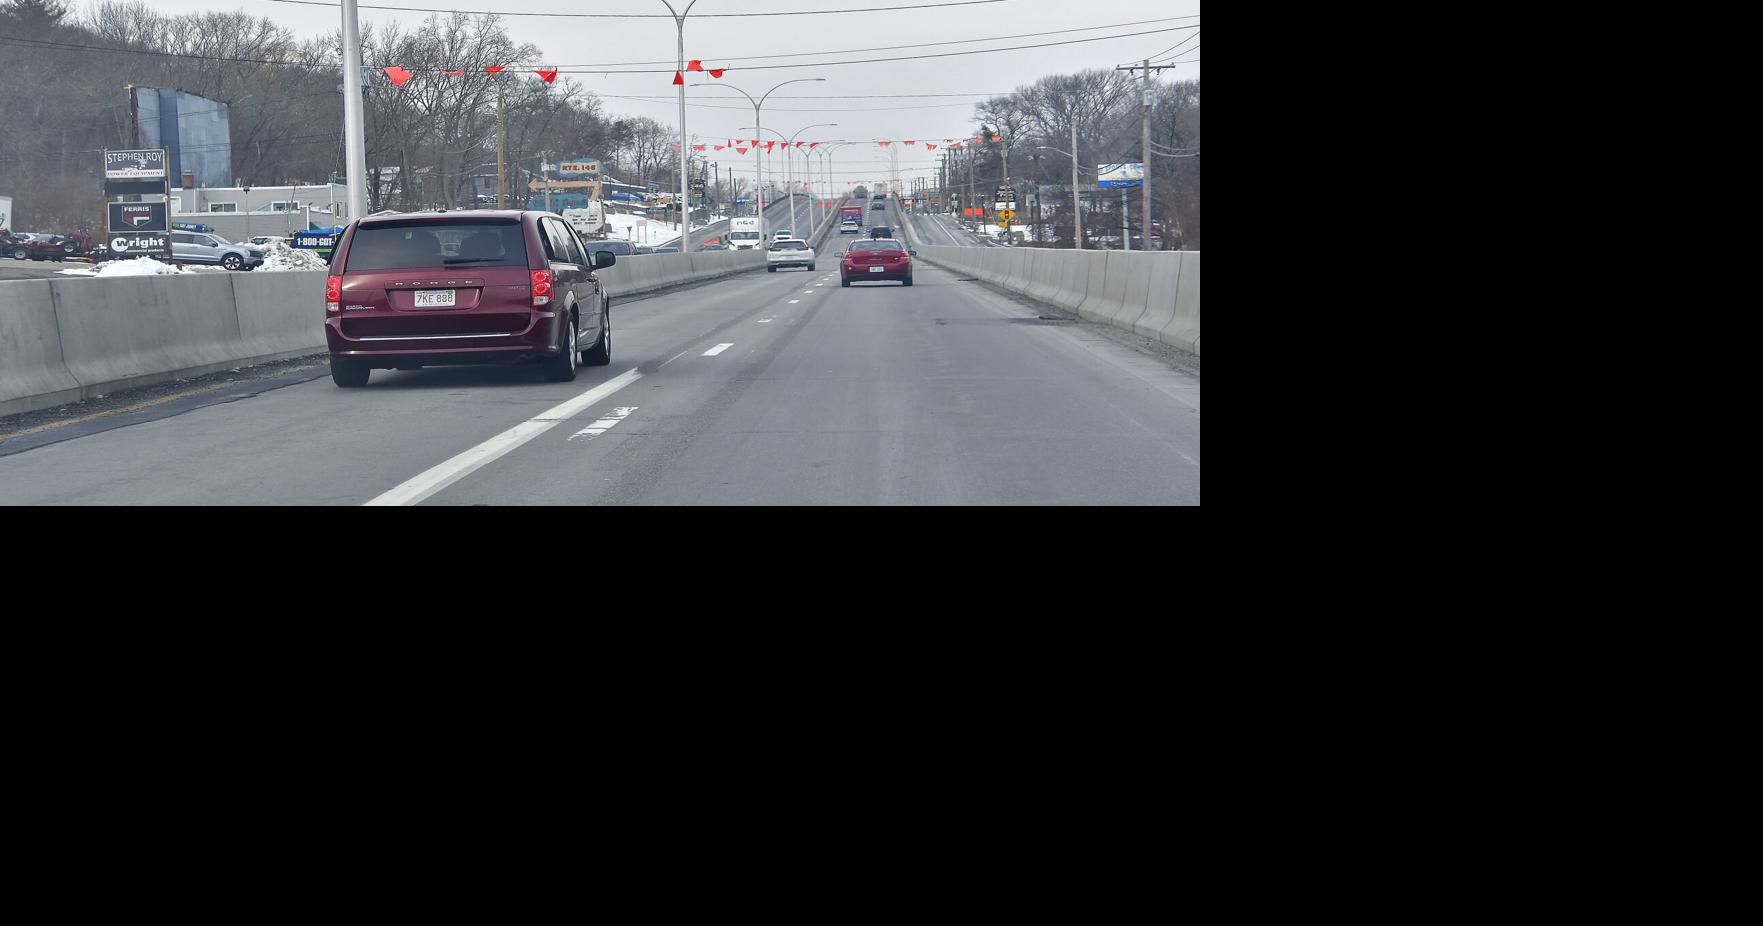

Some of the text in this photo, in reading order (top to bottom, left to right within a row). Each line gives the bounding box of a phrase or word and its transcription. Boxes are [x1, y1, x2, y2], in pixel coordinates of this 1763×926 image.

[107, 152, 162, 164] STEPHEN ROY
[416, 294, 433, 304] 7KE
